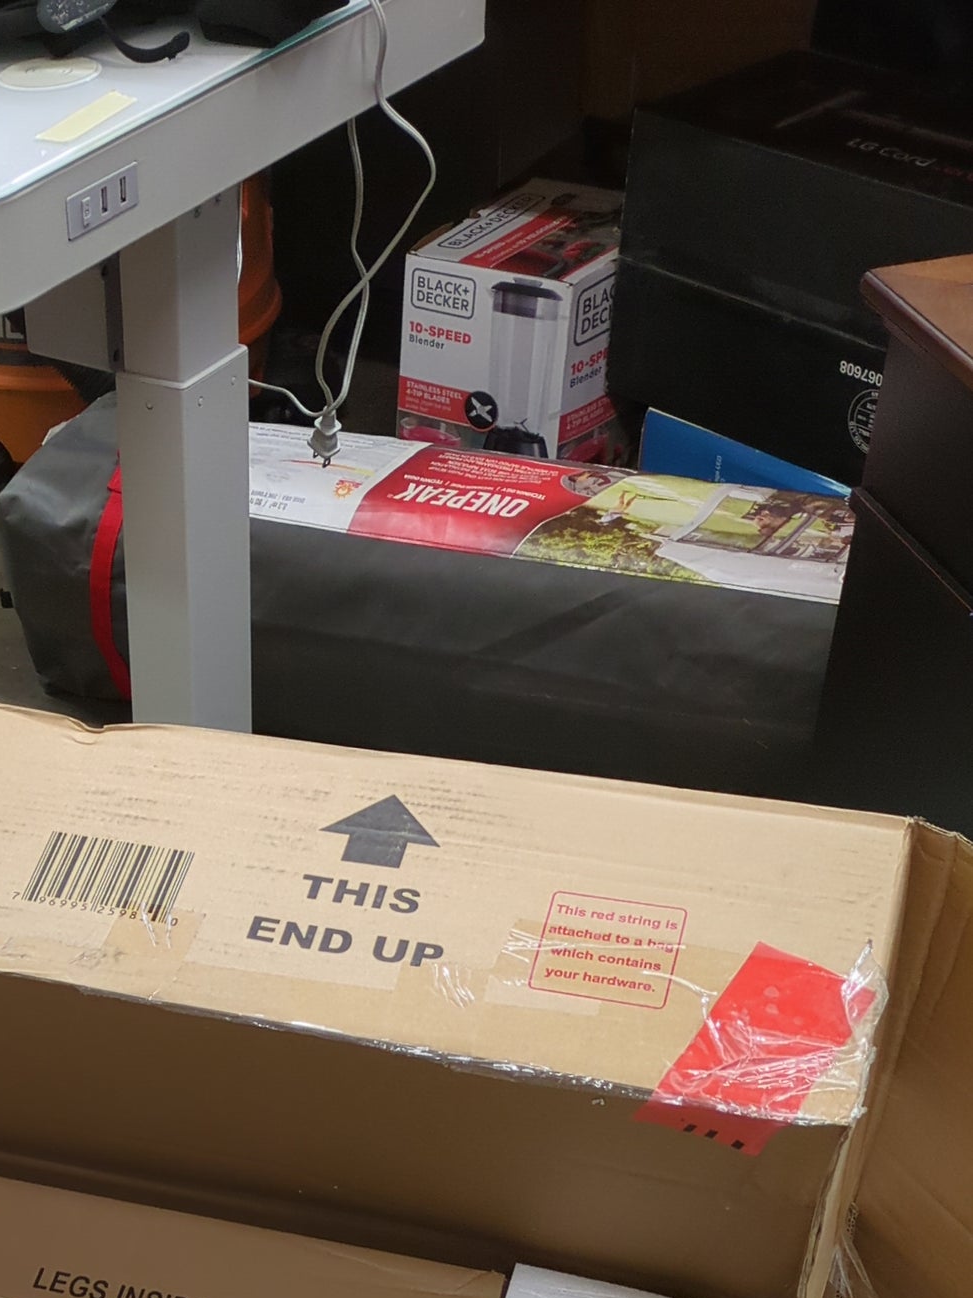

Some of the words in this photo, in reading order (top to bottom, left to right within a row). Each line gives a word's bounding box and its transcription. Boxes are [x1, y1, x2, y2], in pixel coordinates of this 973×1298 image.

[846, 138, 878, 151] LG
[417, 276, 470, 296] BLACK+
[416, 289, 470, 312] DECKER
[409, 320, 472, 345] 10-SPEED
[580, 305, 611, 336] DEC
[408, 333, 445, 350] Blender
[569, 366, 603, 389] Blender
[406, 381, 441, 396] STAINLESS
[442, 387, 463, 401] STEEL
[423, 391, 451, 405] BLADES
[394, 482, 530, 518] ONEPEAK
[302, 873, 422, 914] THIS
[11, 891, 21, 901] 7
[38, 896, 88, 912] 96995
[96, 904, 143, 922] 2598
[557, 903, 587, 917] This
[590, 909, 615, 922] red
[618, 914, 662, 931] string
[665, 919, 678, 930] is
[246, 915, 353, 954] END
[372, 935, 444, 967] UP
[548, 925, 612, 942] attached
[615, 933, 630, 945] to
[633, 937, 643, 947] a
[647, 938, 674, 954] bag
[550, 947, 595, 961] which
[597, 955, 662, 972] contains
[544, 966, 579, 979] your
[582, 970, 656, 993] hardware.
